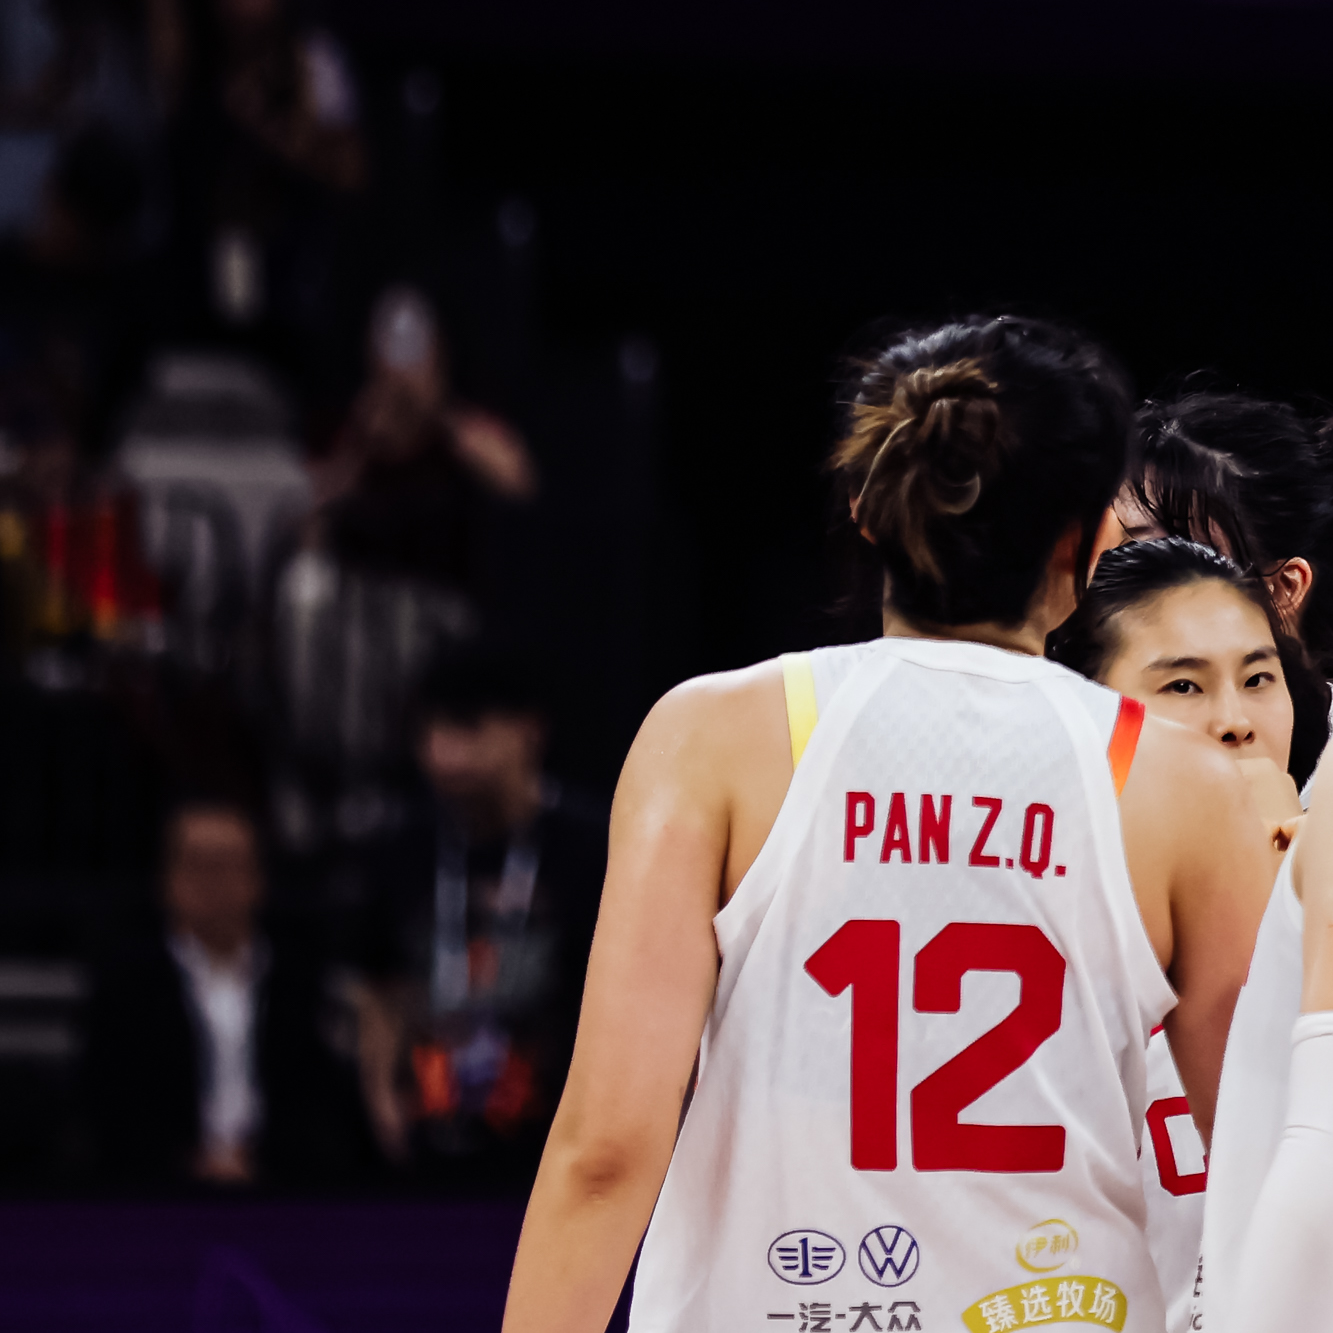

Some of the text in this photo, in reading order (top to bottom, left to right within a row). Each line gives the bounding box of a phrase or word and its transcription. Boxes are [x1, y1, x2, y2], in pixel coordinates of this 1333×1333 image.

[843, 791, 1067, 879] PAN Z.Q.
[803, 918, 1068, 1174] 12
